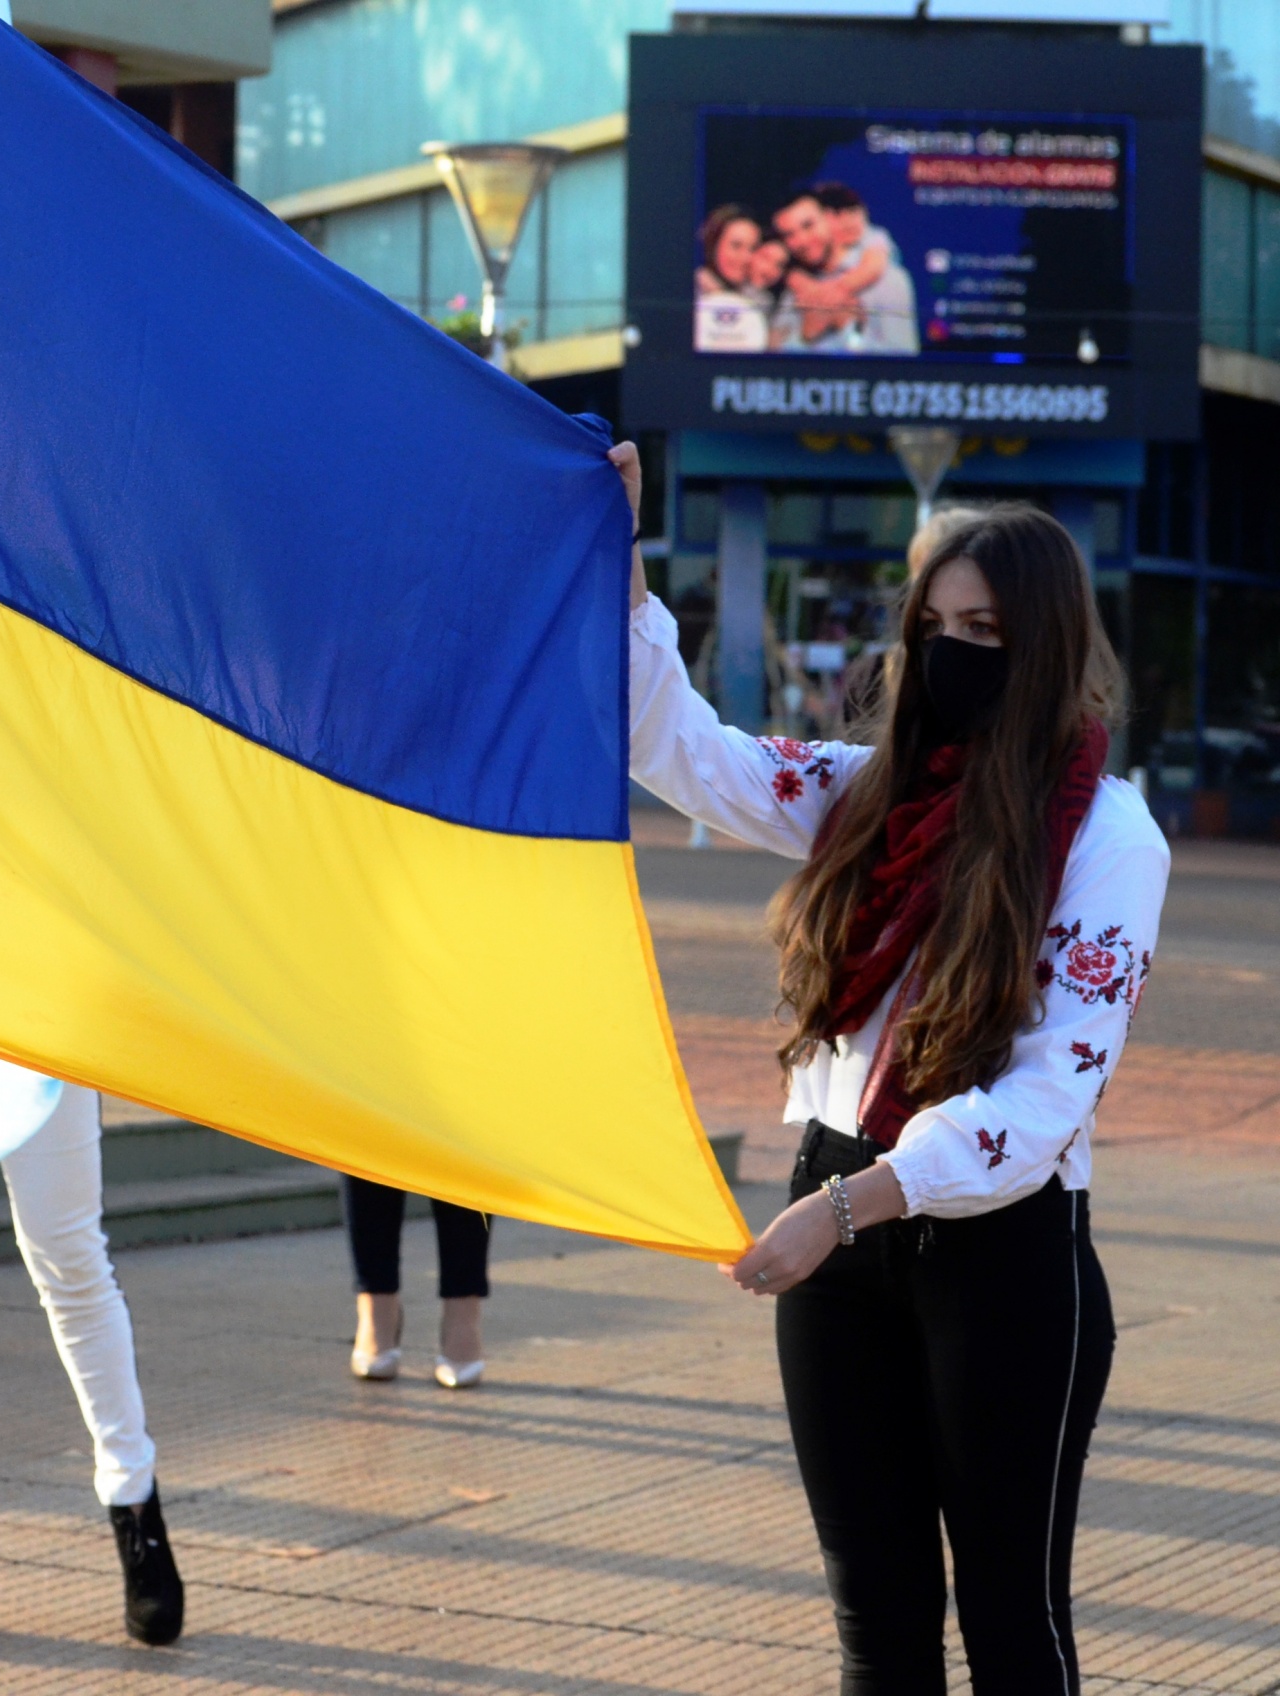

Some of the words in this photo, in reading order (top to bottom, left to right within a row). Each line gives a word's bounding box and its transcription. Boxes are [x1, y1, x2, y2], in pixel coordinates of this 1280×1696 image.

[867, 125, 974, 154] Sistema
[977, 129, 1012, 156] de
[1015, 131, 1118, 158] alarmas
[712, 376, 869, 416] PUBLICITE
